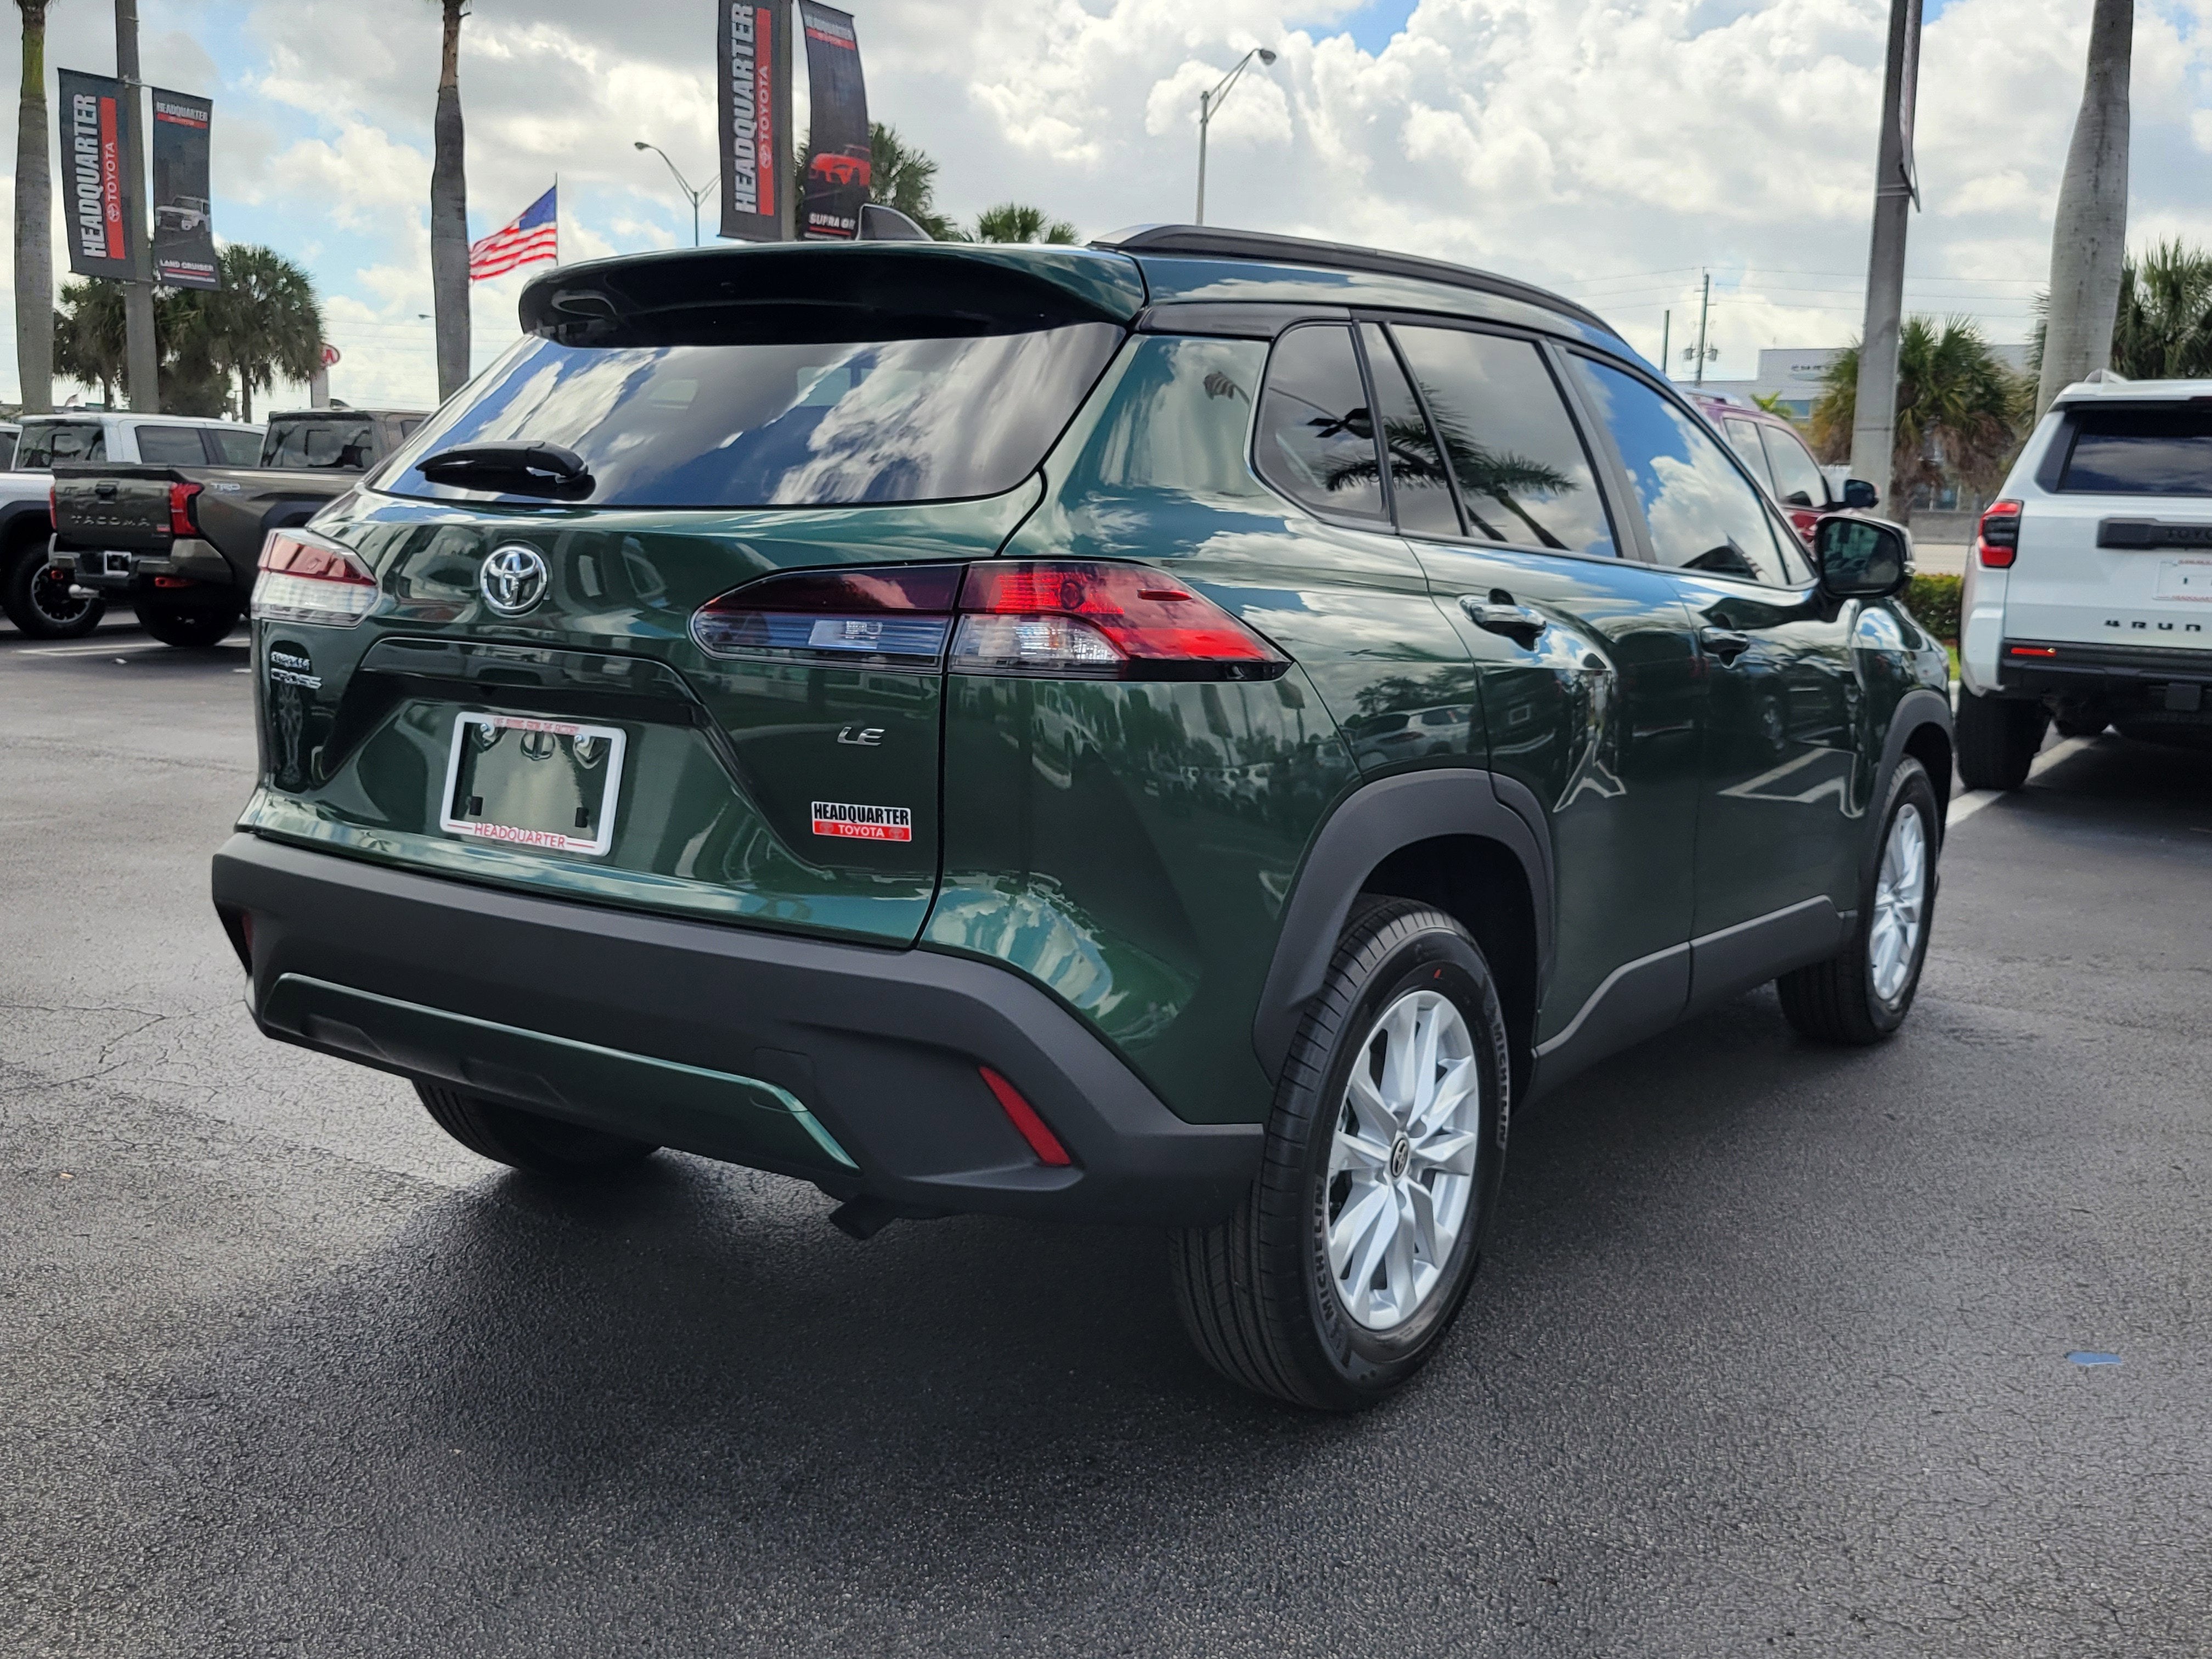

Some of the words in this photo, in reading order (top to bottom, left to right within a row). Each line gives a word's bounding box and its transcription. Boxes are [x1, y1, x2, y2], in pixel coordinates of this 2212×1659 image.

[731, 2, 757, 215] HEADQUARTER
[758, 65, 770, 142] TOYOTA
[73, 93, 108, 258] HEADQUARTER
[105, 142, 119, 203] TOYOTA
[809, 211, 840, 228] SUPRA
[159, 258, 180, 268] LAND
[180, 261, 215, 272] CRUISER
[70, 515, 151, 527] TACOMA
[270, 667, 323, 690] CROSS
[837, 726, 885, 746] LE
[814, 803, 909, 825] HEADQUARTER
[475, 822, 566, 848] HEADQUARTER
[838, 824, 885, 838] TOYOTA
[1492, 1022, 1508, 1143] MICHELIN
[1314, 1182, 1334, 1321] MICHELIN
